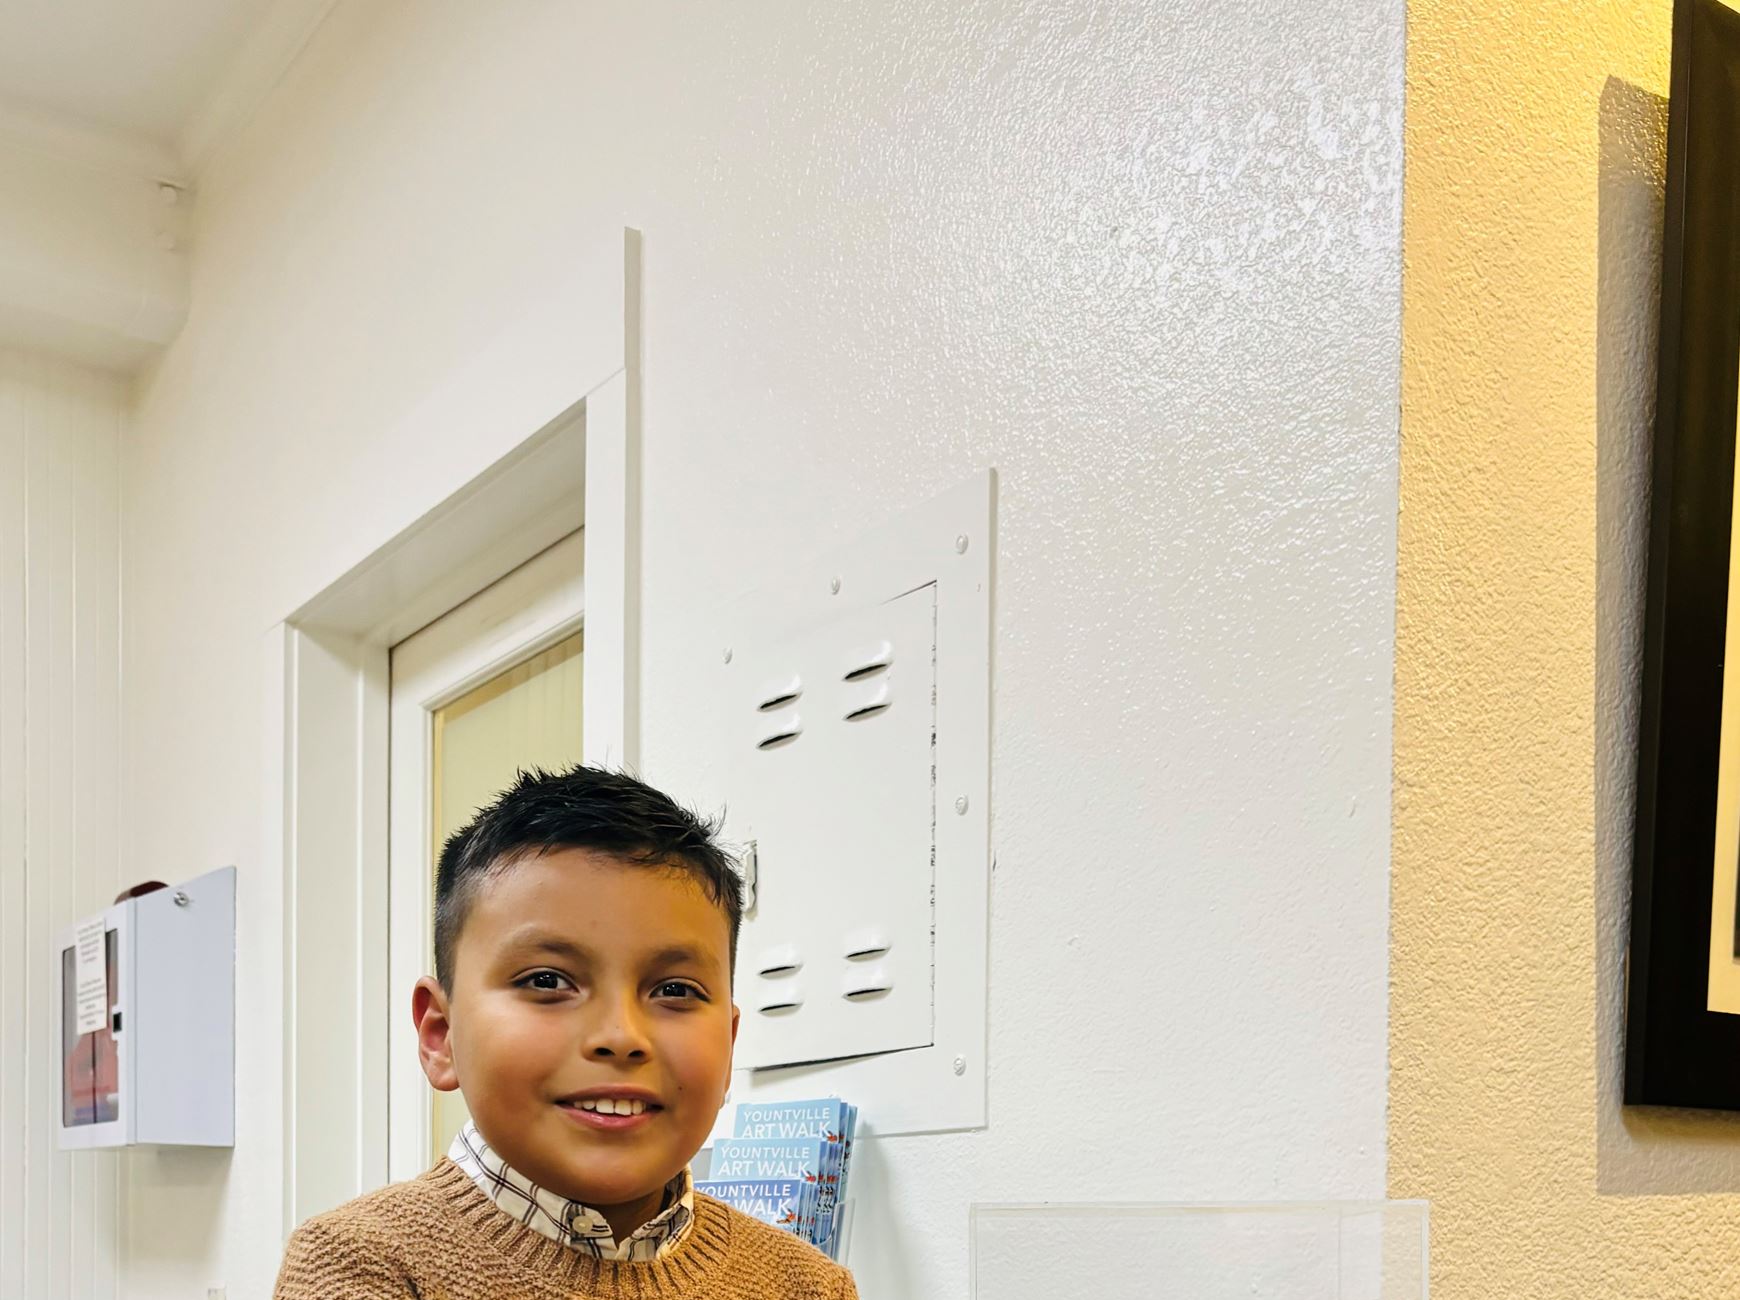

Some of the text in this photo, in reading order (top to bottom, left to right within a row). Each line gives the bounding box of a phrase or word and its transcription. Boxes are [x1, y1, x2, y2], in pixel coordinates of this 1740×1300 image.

[743, 1107, 831, 1123] YOUNTVILLE
[741, 1121, 832, 1138] ART WALK
[720, 1147, 810, 1160] YOUNTVILLE
[718, 1160, 811, 1178] ART WALK
[733, 1198, 792, 1216] WALK
